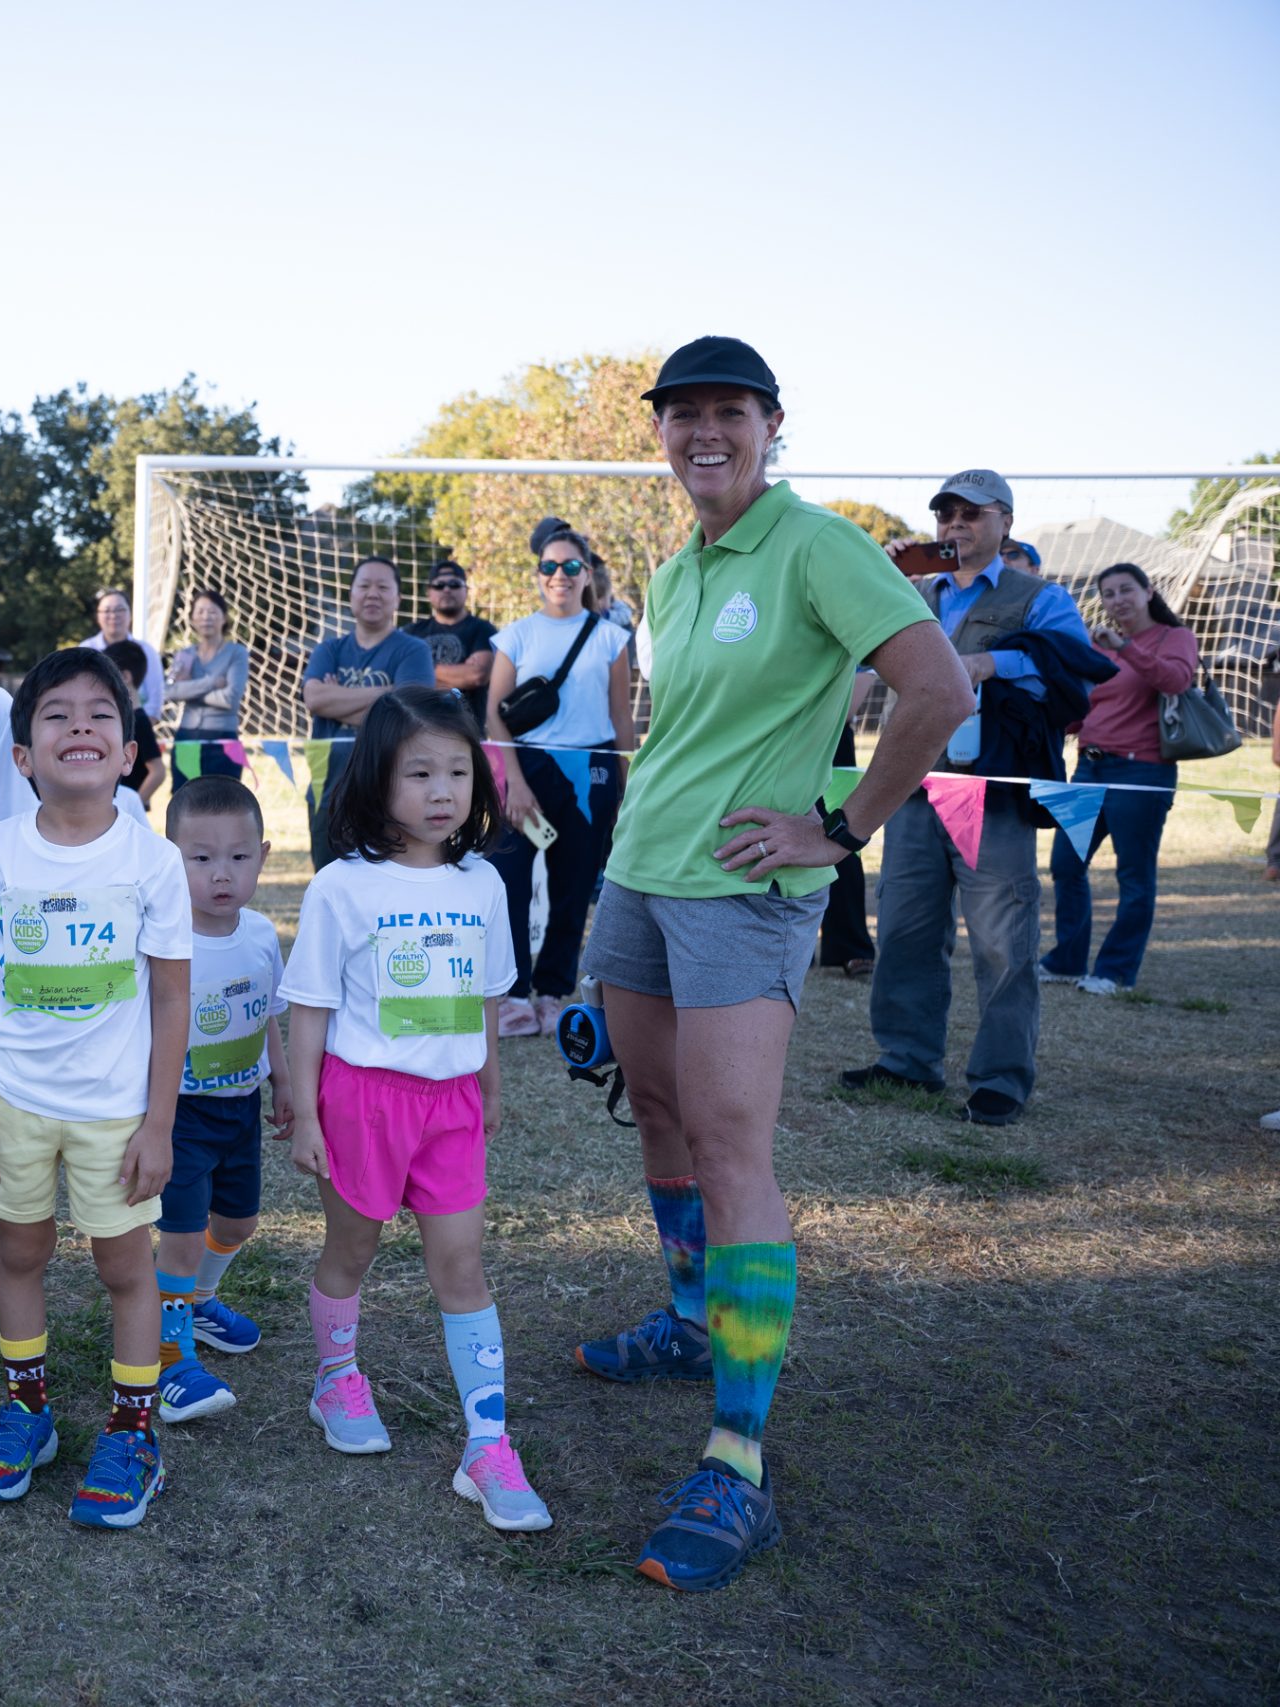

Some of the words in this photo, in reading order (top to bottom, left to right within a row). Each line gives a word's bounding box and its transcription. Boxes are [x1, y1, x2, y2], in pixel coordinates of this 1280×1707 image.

[720, 613, 748, 627] KIDS
[14, 925, 43, 938] KIDS
[65, 921, 116, 946] 174
[392, 953, 425, 961] HEALTHY
[392, 960, 425, 972] KIDS
[448, 957, 474, 978] 114
[199, 1004, 225, 1013] HEALTHY
[243, 994, 268, 1020] 109
[200, 1010, 227, 1023] KIDS
